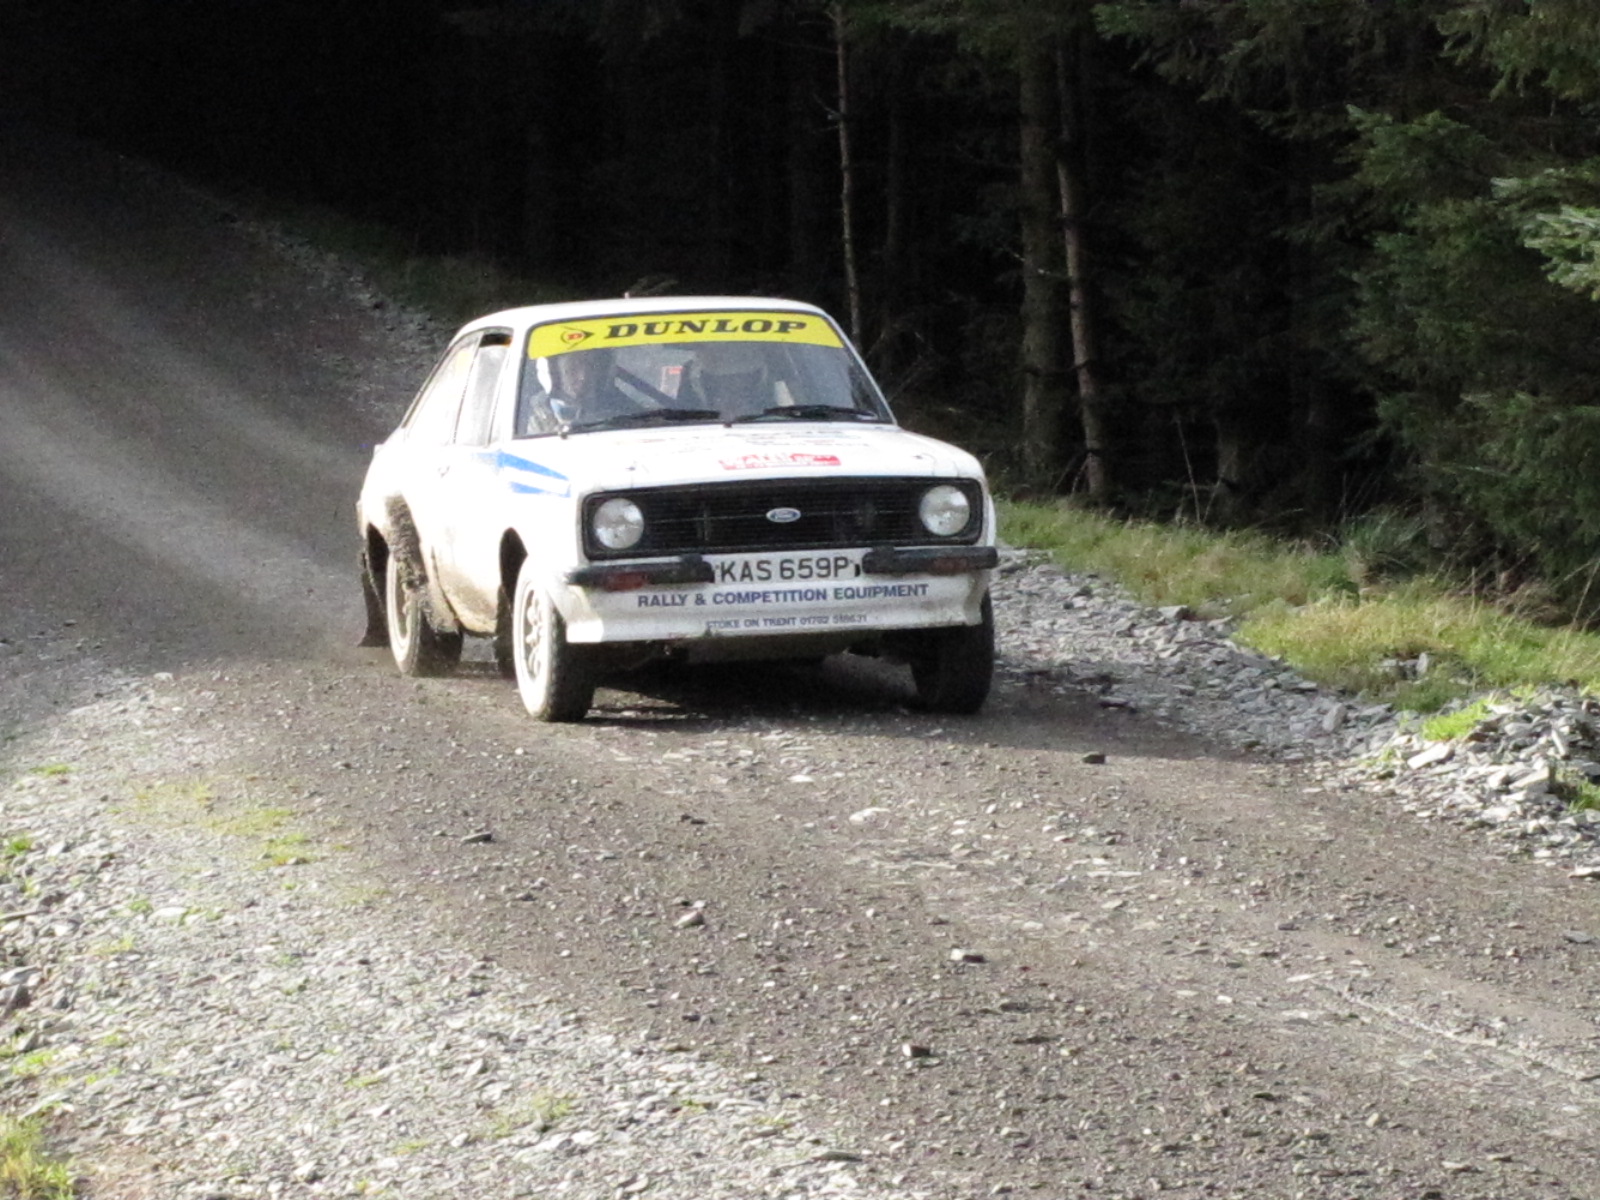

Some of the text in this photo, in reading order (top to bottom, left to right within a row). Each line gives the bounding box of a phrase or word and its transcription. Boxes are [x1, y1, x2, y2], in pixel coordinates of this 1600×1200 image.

[604, 318, 806, 339] DUNLOP
[721, 557, 848, 582] KAS 659P
[637, 583, 930, 607] RALLY & COMPETITION EQUIPMENT
[744, 618, 759, 627] ON
[763, 616, 797, 626] TRENT
